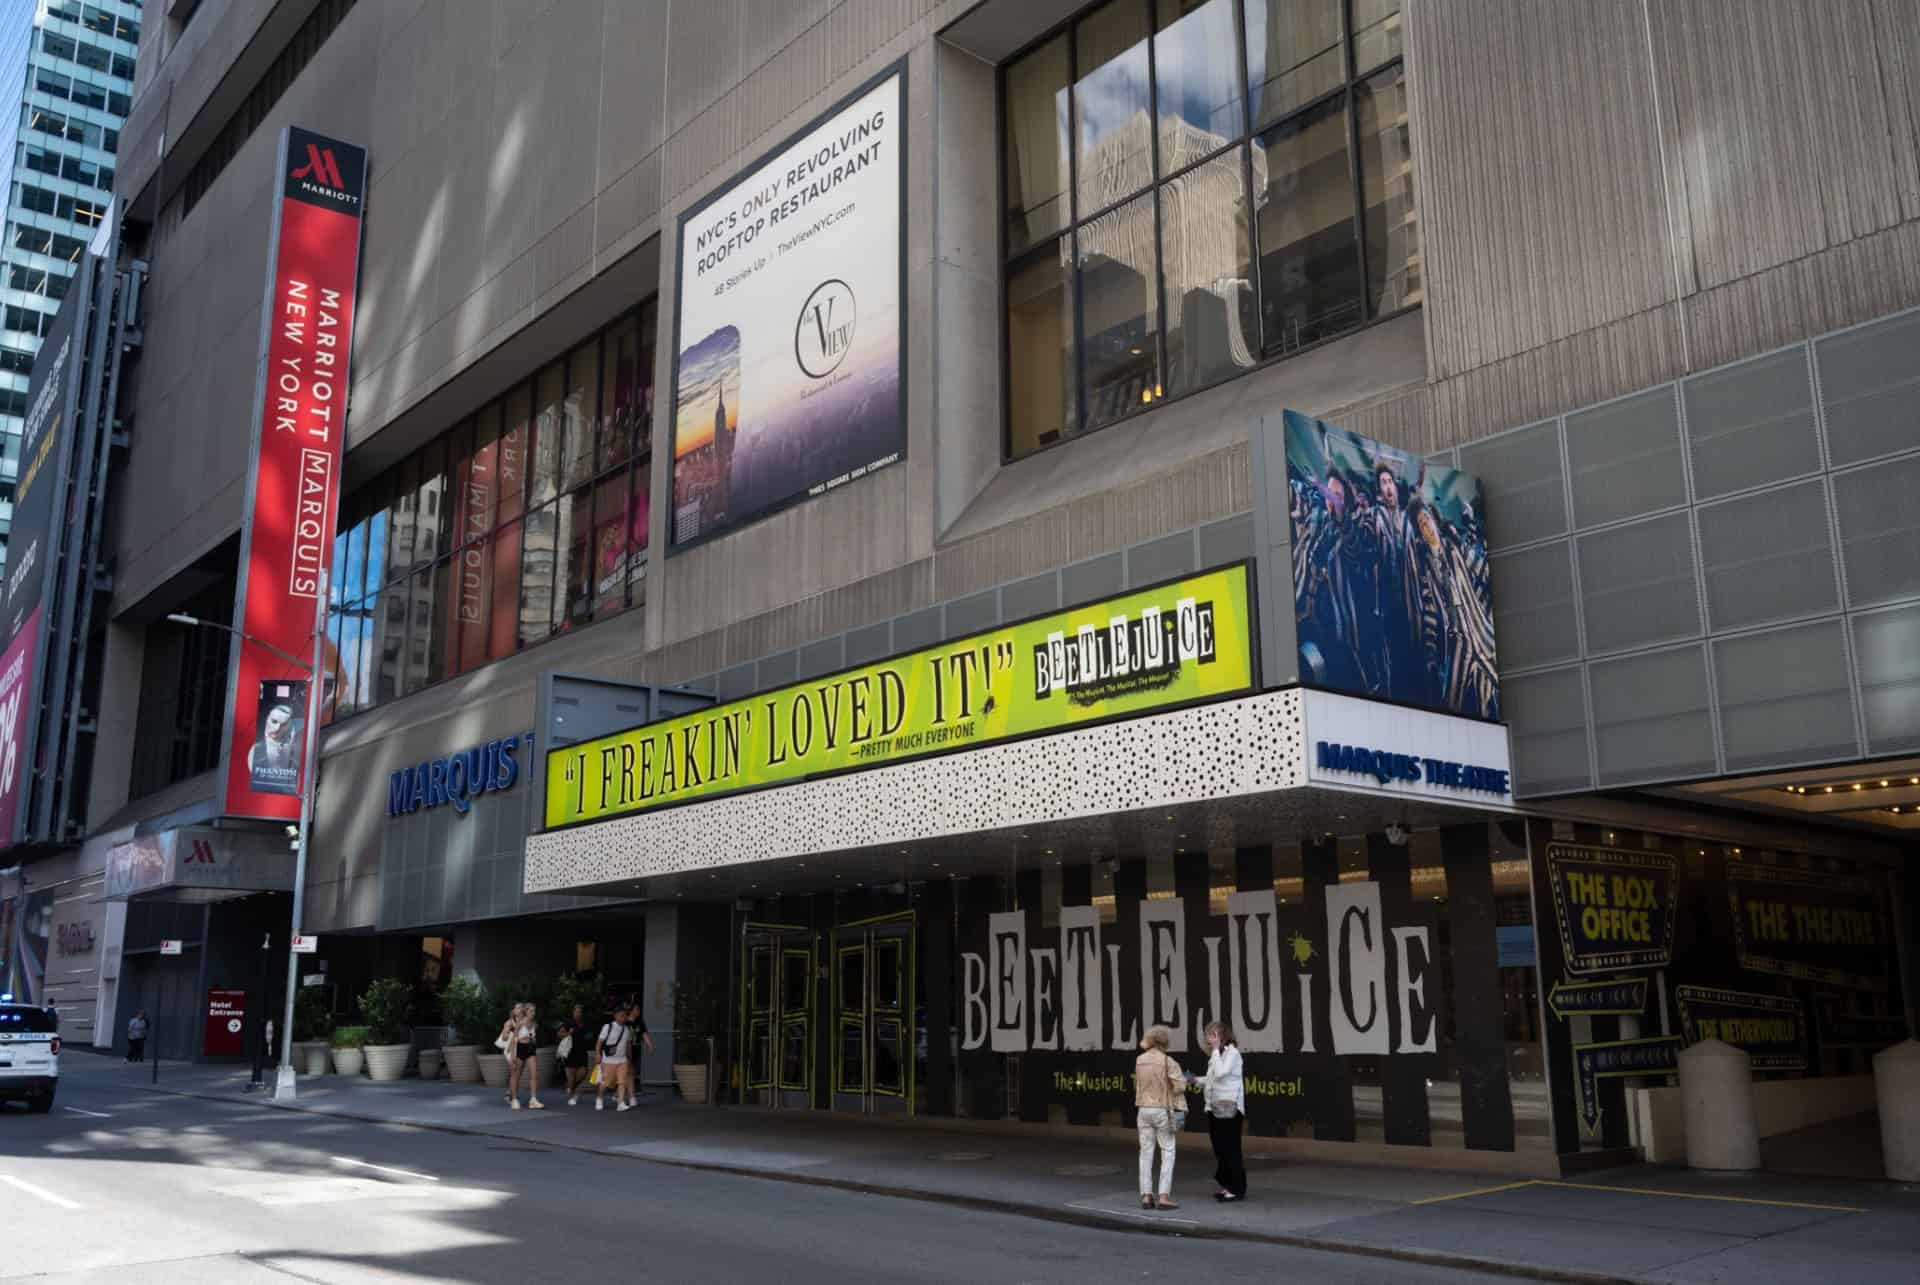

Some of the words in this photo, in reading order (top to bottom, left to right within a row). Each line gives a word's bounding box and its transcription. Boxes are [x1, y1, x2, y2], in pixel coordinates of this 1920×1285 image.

[302, 182, 359, 204] MARRIOTT
[697, 211, 737, 252] NYC'S
[742, 178, 781, 218] ONLY
[786, 111, 885, 189] REVOLVING
[697, 218, 765, 276] ROOFTOP
[770, 141, 881, 227] RESTAURANT
[778, 203, 856, 257] TheViewNYC.com
[283, 279, 308, 345] NEW
[308, 287, 340, 443] MARRIOTT
[275, 357, 301, 433] YORK
[295, 454, 327, 594] MARQUIS
[766, 668, 906, 767] LOVED
[895, 733, 922, 750] MUCH
[925, 722, 976, 745] EVERYONE
[386, 736, 520, 817] MARQUIS
[1317, 741, 1422, 784] MARQUIS
[1423, 759, 1511, 793] THEATRE
[1566, 872, 1607, 905] THE
[1611, 874, 1659, 910] BOX
[1582, 907, 1652, 942] OFFICE
[1745, 900, 1790, 941] THE
[209, 1000, 232, 1008] Hotel
[209, 1008, 244, 1017] Entrance
[1053, 1071, 1074, 1090] The
